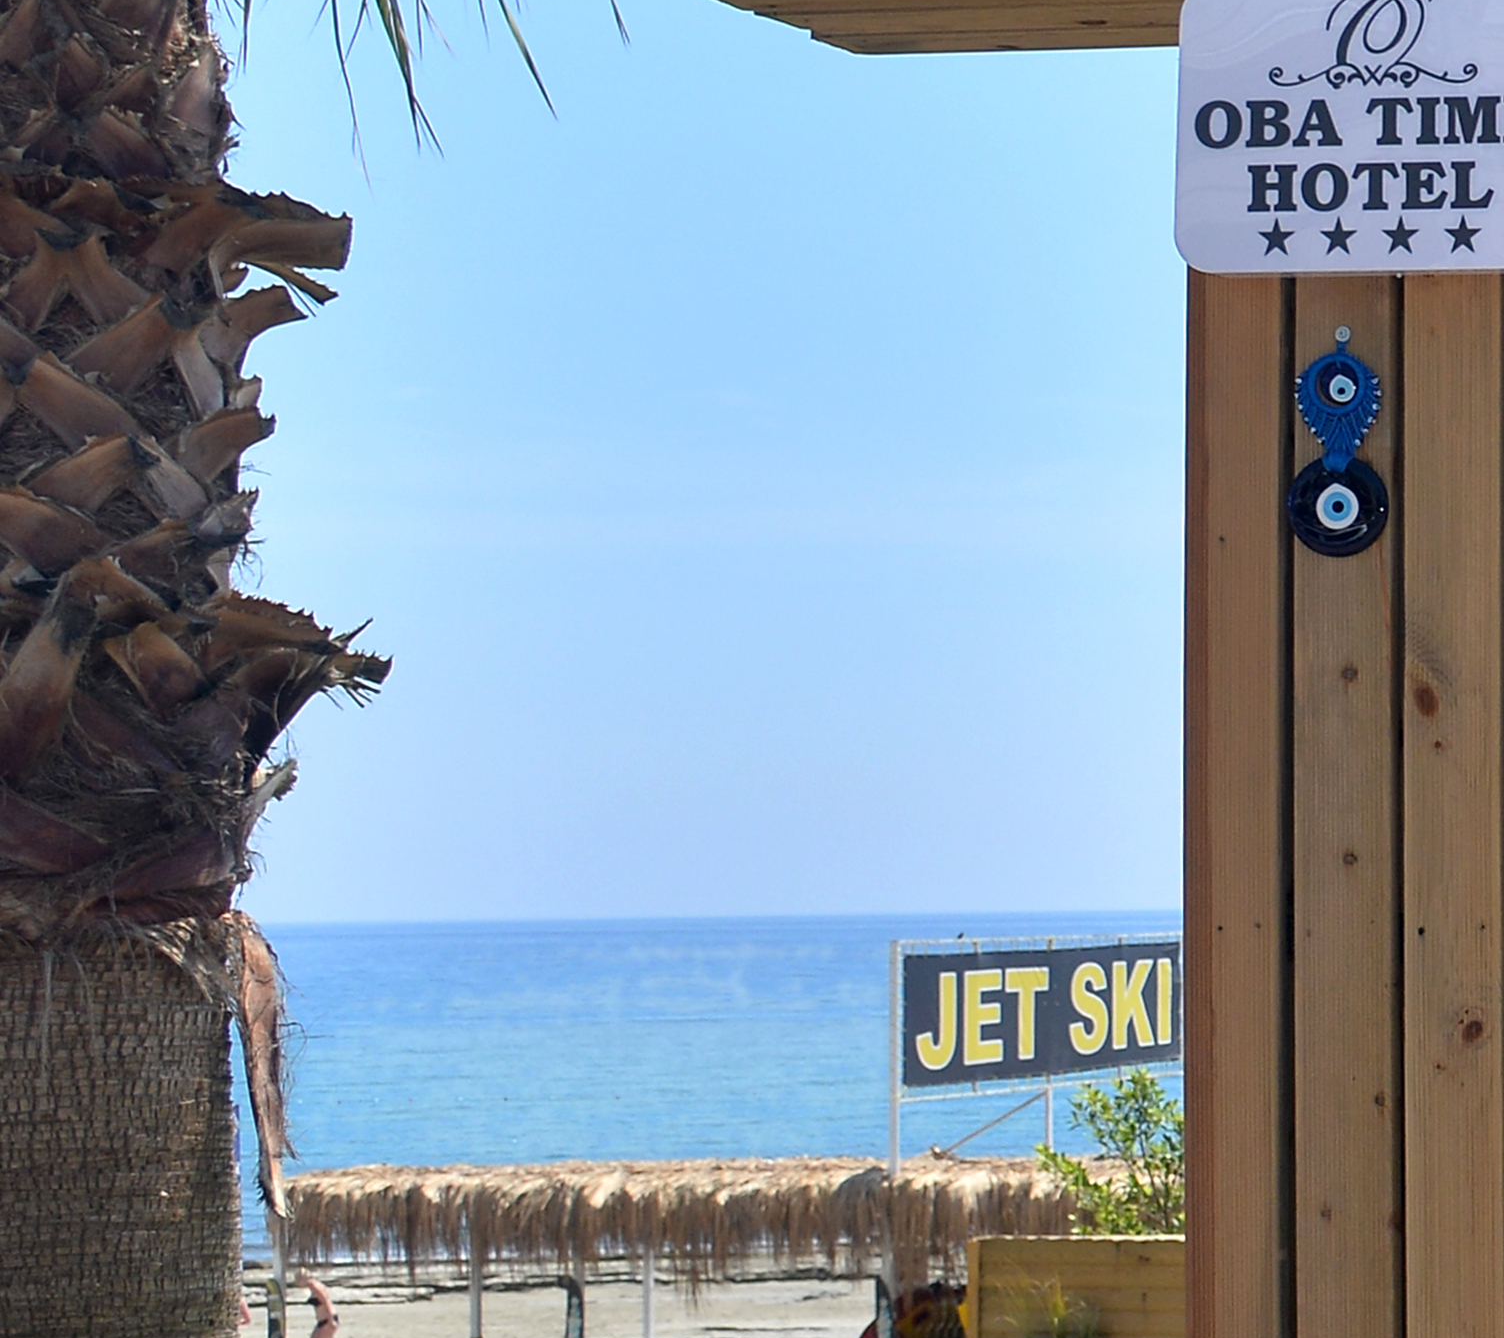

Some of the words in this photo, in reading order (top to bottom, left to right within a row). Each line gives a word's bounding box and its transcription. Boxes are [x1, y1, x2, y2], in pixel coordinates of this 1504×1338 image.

[1194, 99, 1343, 149] OBA
[1246, 160, 1495, 213] HOTEL
[915, 966, 1050, 1072] JET
[1068, 957, 1173, 1056] SKI
